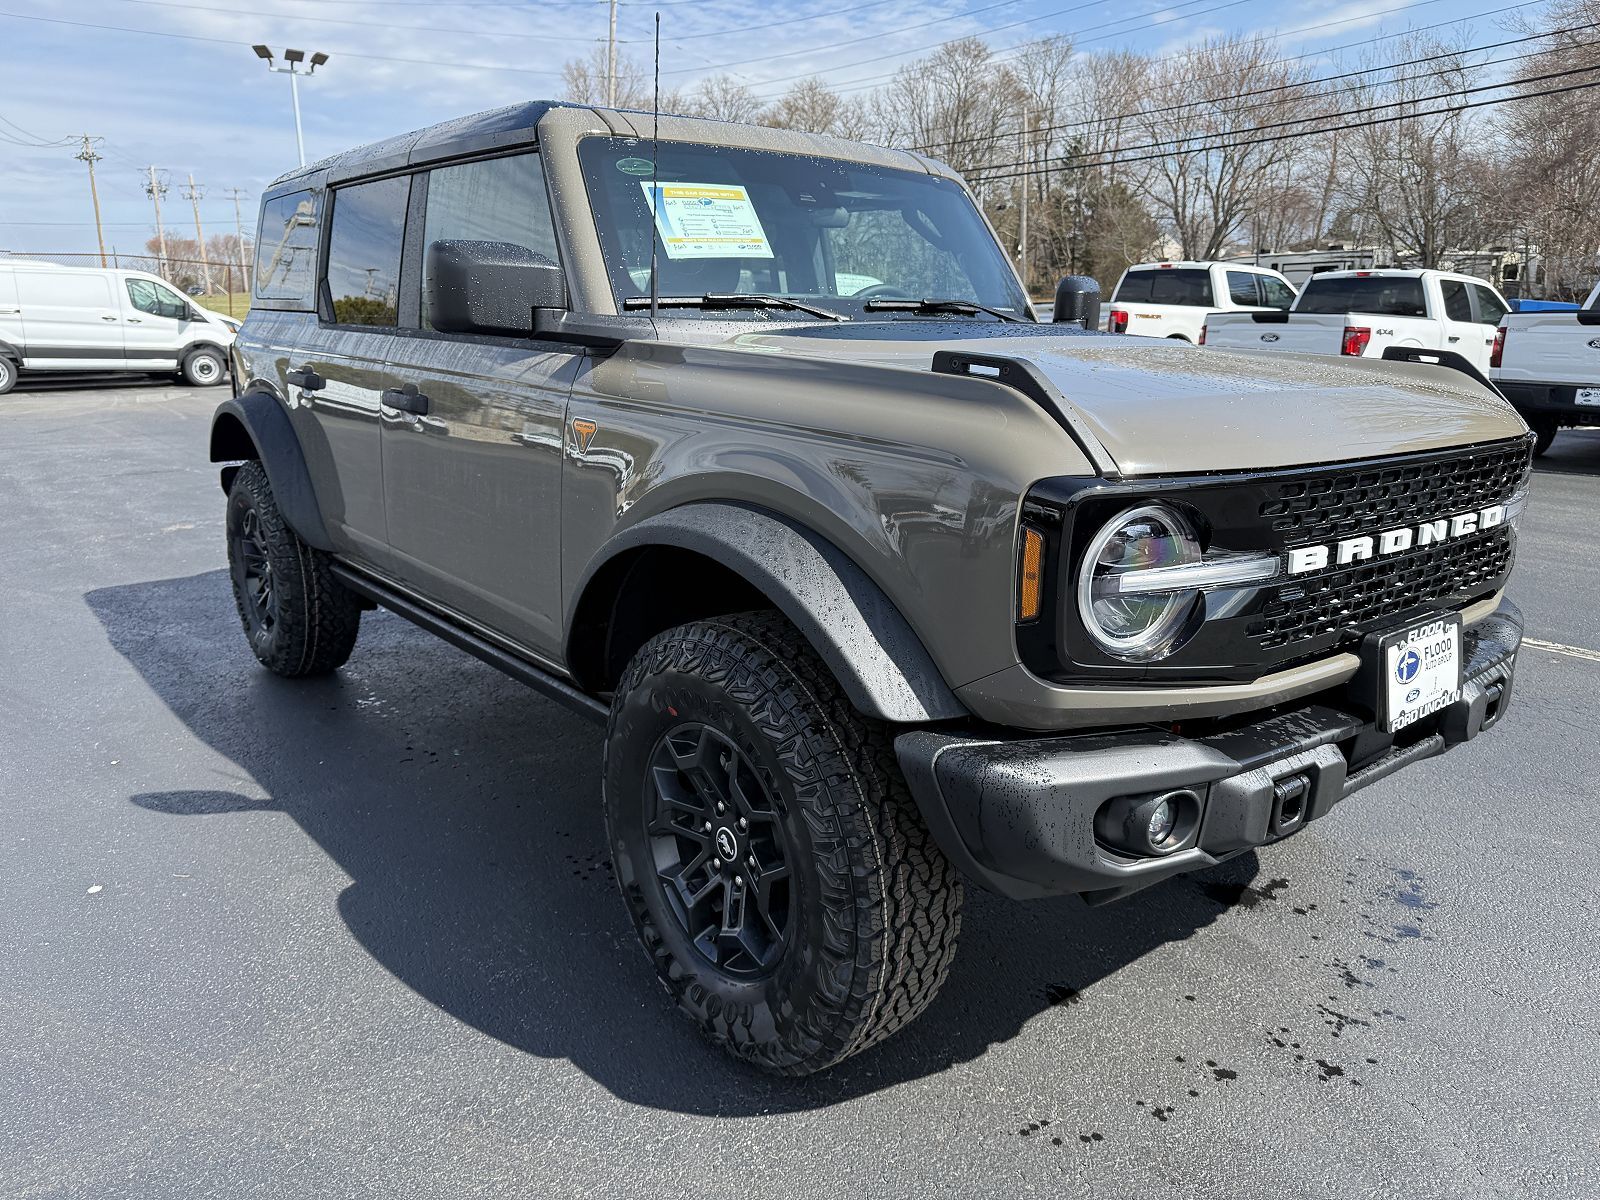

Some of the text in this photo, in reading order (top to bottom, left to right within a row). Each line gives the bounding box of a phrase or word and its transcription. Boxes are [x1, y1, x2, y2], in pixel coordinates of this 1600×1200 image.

[1288, 505, 1503, 575] BRONCO
[1407, 620, 1444, 644] FLOOD
[1424, 637, 1452, 660] FLOOD
[1425, 652, 1453, 671] AUTO GROUP
[1391, 689, 1461, 733] FORD LINCOLN
